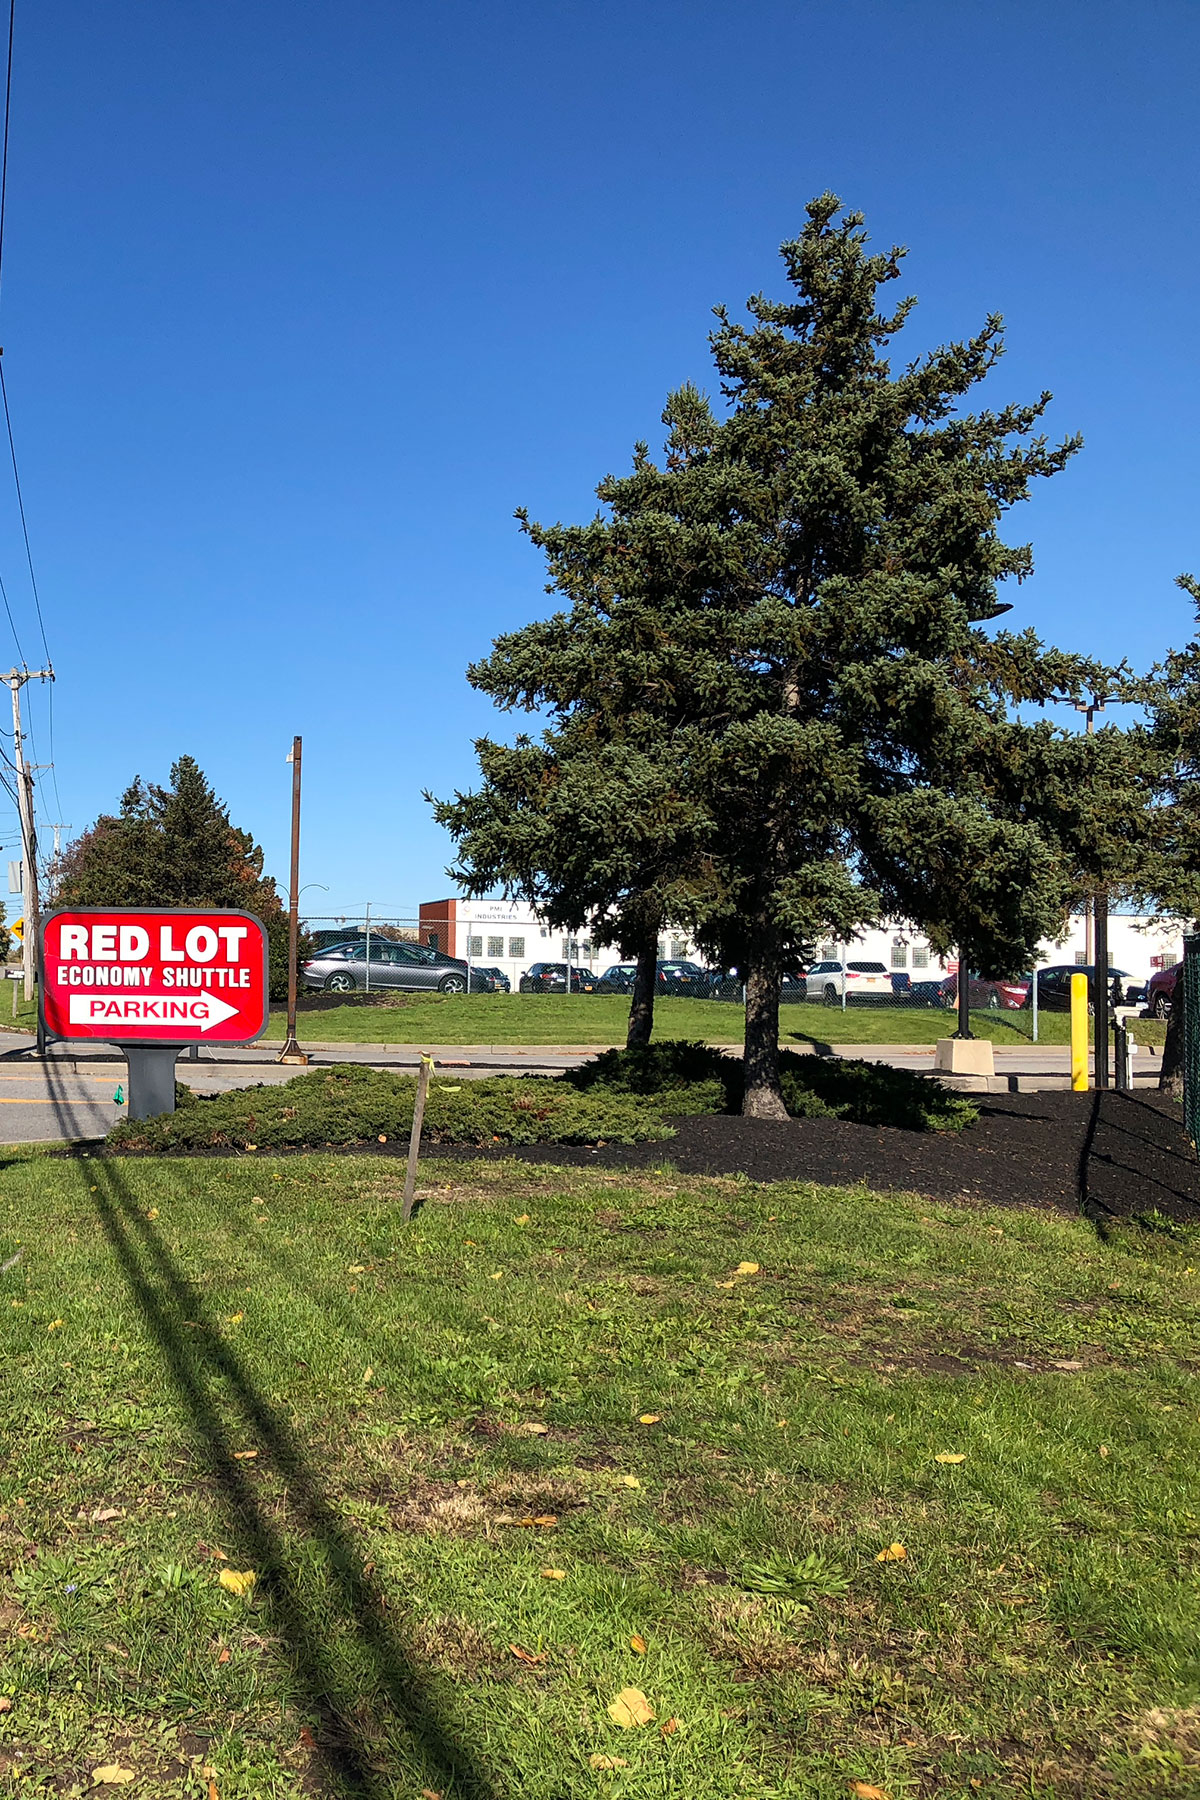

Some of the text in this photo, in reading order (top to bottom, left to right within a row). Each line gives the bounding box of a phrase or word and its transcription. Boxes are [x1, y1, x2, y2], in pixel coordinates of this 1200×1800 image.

[59, 924, 248, 963] RED LOT
[57, 966, 250, 988] ECONOMY SHUTTLE
[89, 1001, 210, 1019] PARKING
